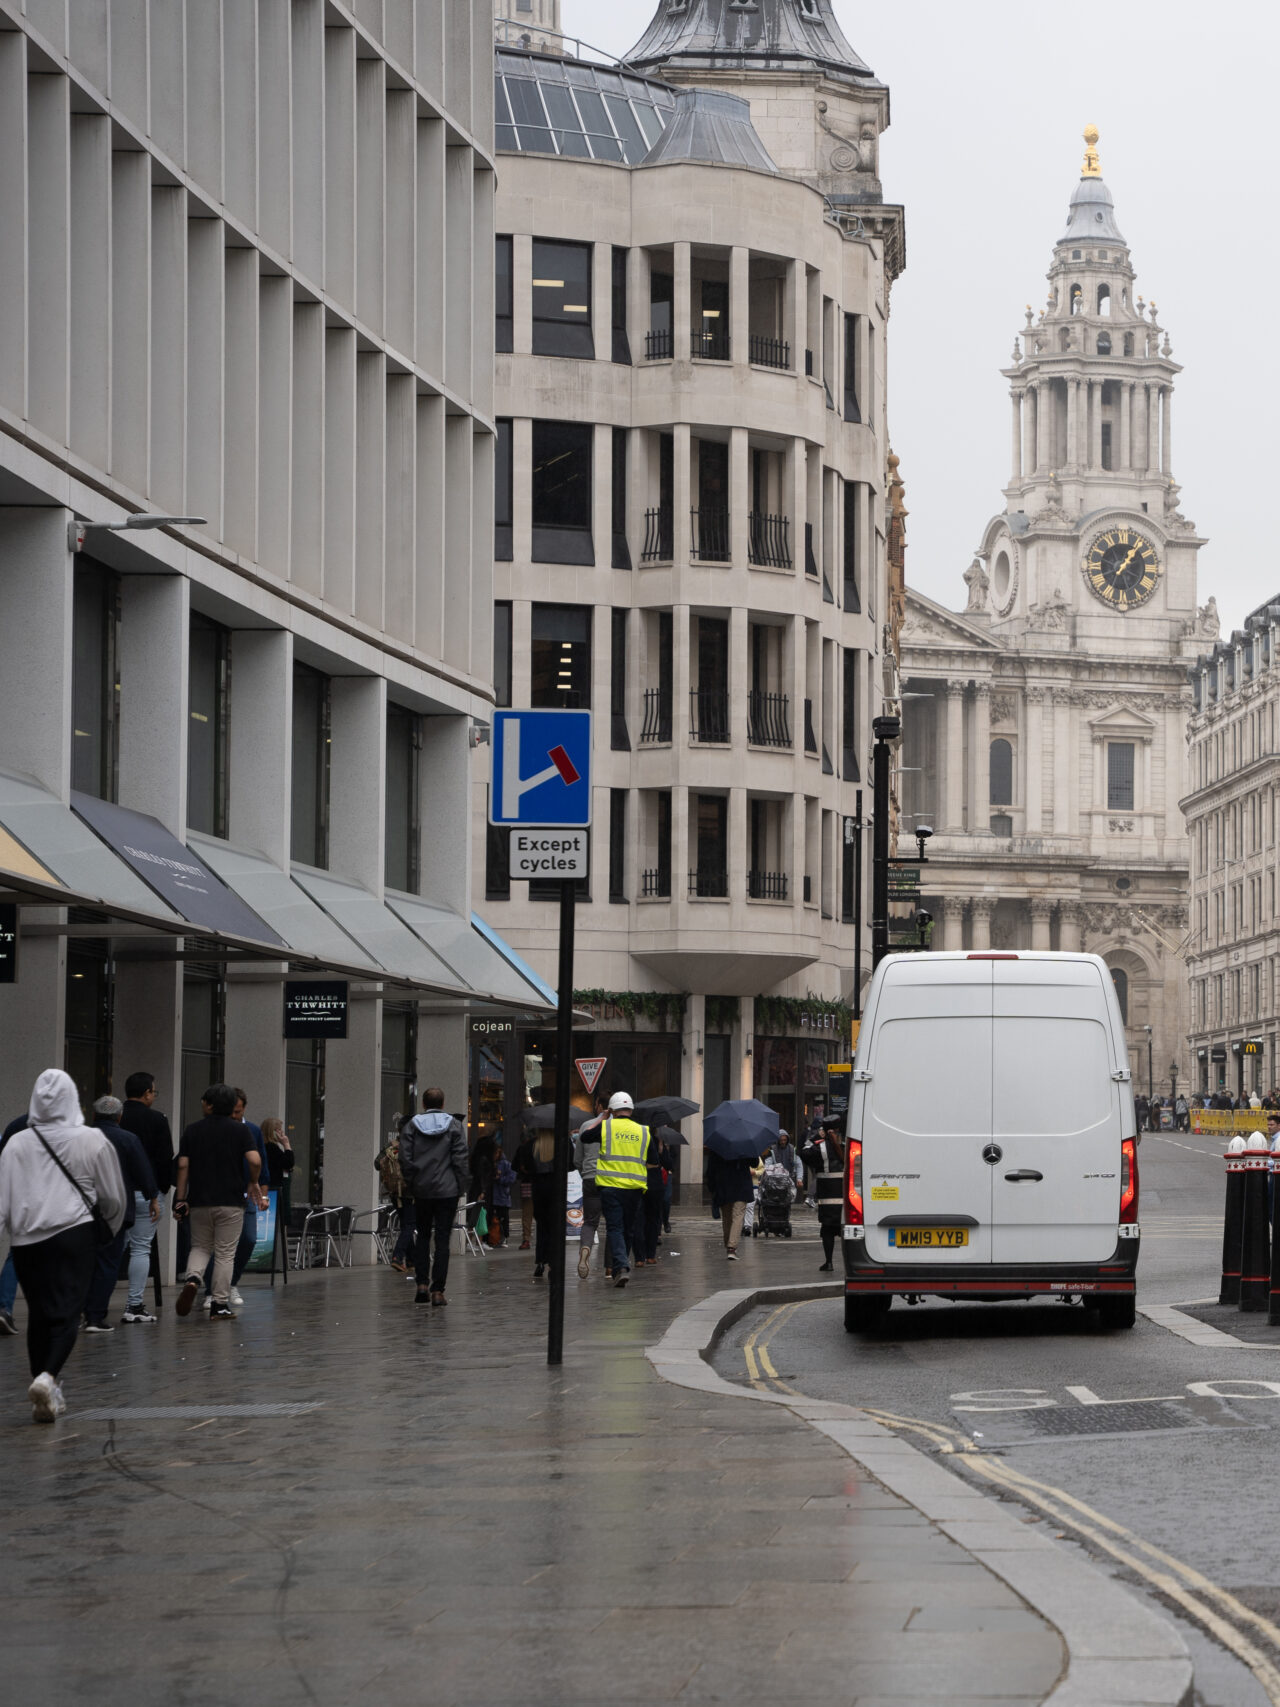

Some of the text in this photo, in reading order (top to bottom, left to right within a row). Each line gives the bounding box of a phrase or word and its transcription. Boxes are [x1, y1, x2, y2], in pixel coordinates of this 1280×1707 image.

[518, 836, 580, 854] Except
[520, 855, 577, 873] cycles
[286, 1001, 347, 1009] TYRWHITT
[472, 1020, 512, 1034] cojean
[581, 1062, 599, 1070] GIVE
[615, 1132, 640, 1142] SYKES
[900, 1231, 964, 1245] WM19 YYB
